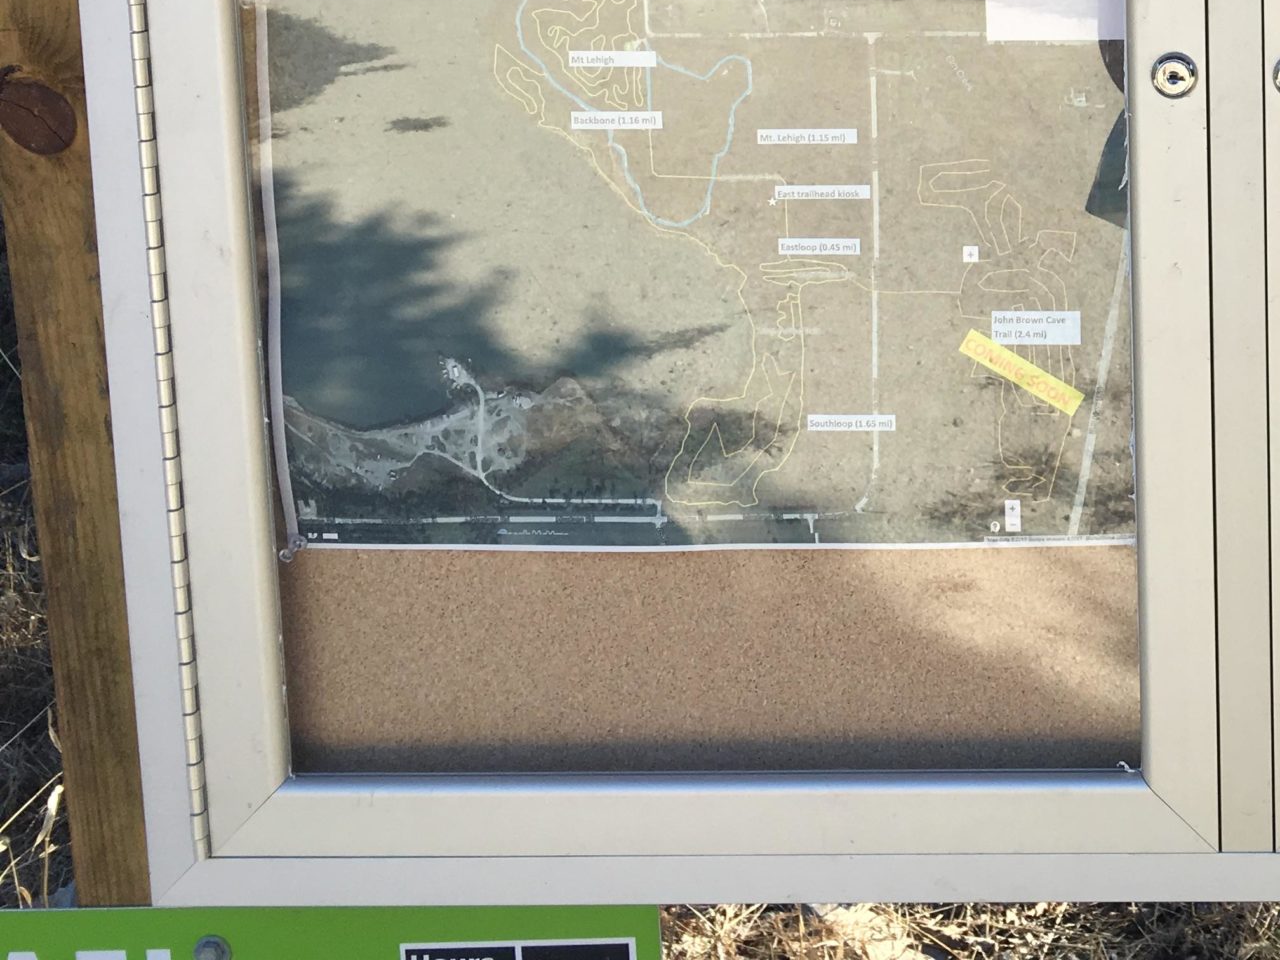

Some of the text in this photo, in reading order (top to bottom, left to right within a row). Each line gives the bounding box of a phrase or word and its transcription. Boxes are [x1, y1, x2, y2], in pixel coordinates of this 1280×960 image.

[571, 54, 615, 66] Mt Lehigh
[573, 116, 657, 127] Backbone (1.16 mi)
[760, 132, 846, 144] Mt. Lehigh (1.15 mi)
[777, 189, 860, 199] East trailhead kiosk
[780, 243, 817, 254] Eastloop
[841, 242, 857, 254] mi)
[994, 316, 1066, 324] John Brown Cave
[994, 330, 1047, 340] Trail (2.4 mi)
[965, 338, 1071, 406] COMING SOON
[809, 419, 893, 431] Southloop (1.65 mi)
